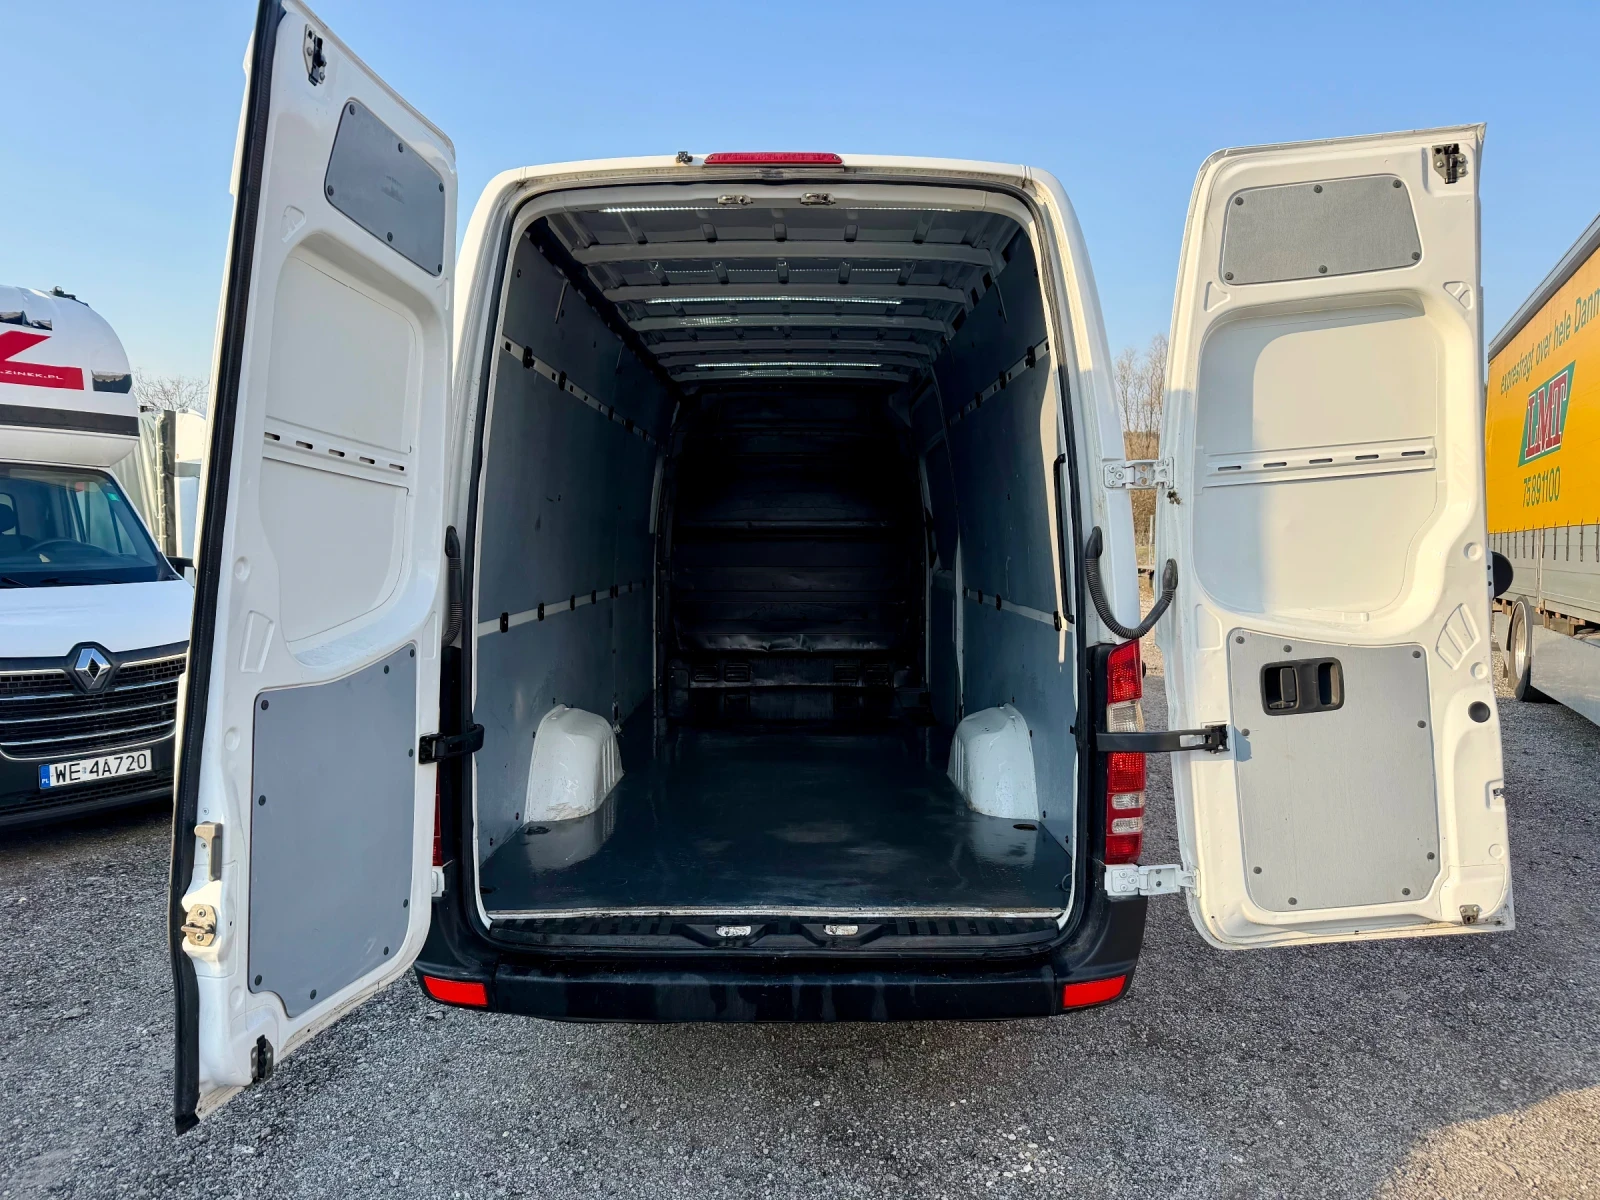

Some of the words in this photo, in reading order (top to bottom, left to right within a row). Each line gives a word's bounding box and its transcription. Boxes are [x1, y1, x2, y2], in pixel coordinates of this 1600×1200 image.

[1536, 331, 1553, 366] over
[1553, 309, 1571, 351] hele
[1525, 370, 1569, 461] LMT
[1523, 466, 1561, 507] 75891100
[54, 763, 81, 783] WE
[88, 753, 147, 777] 4A720
